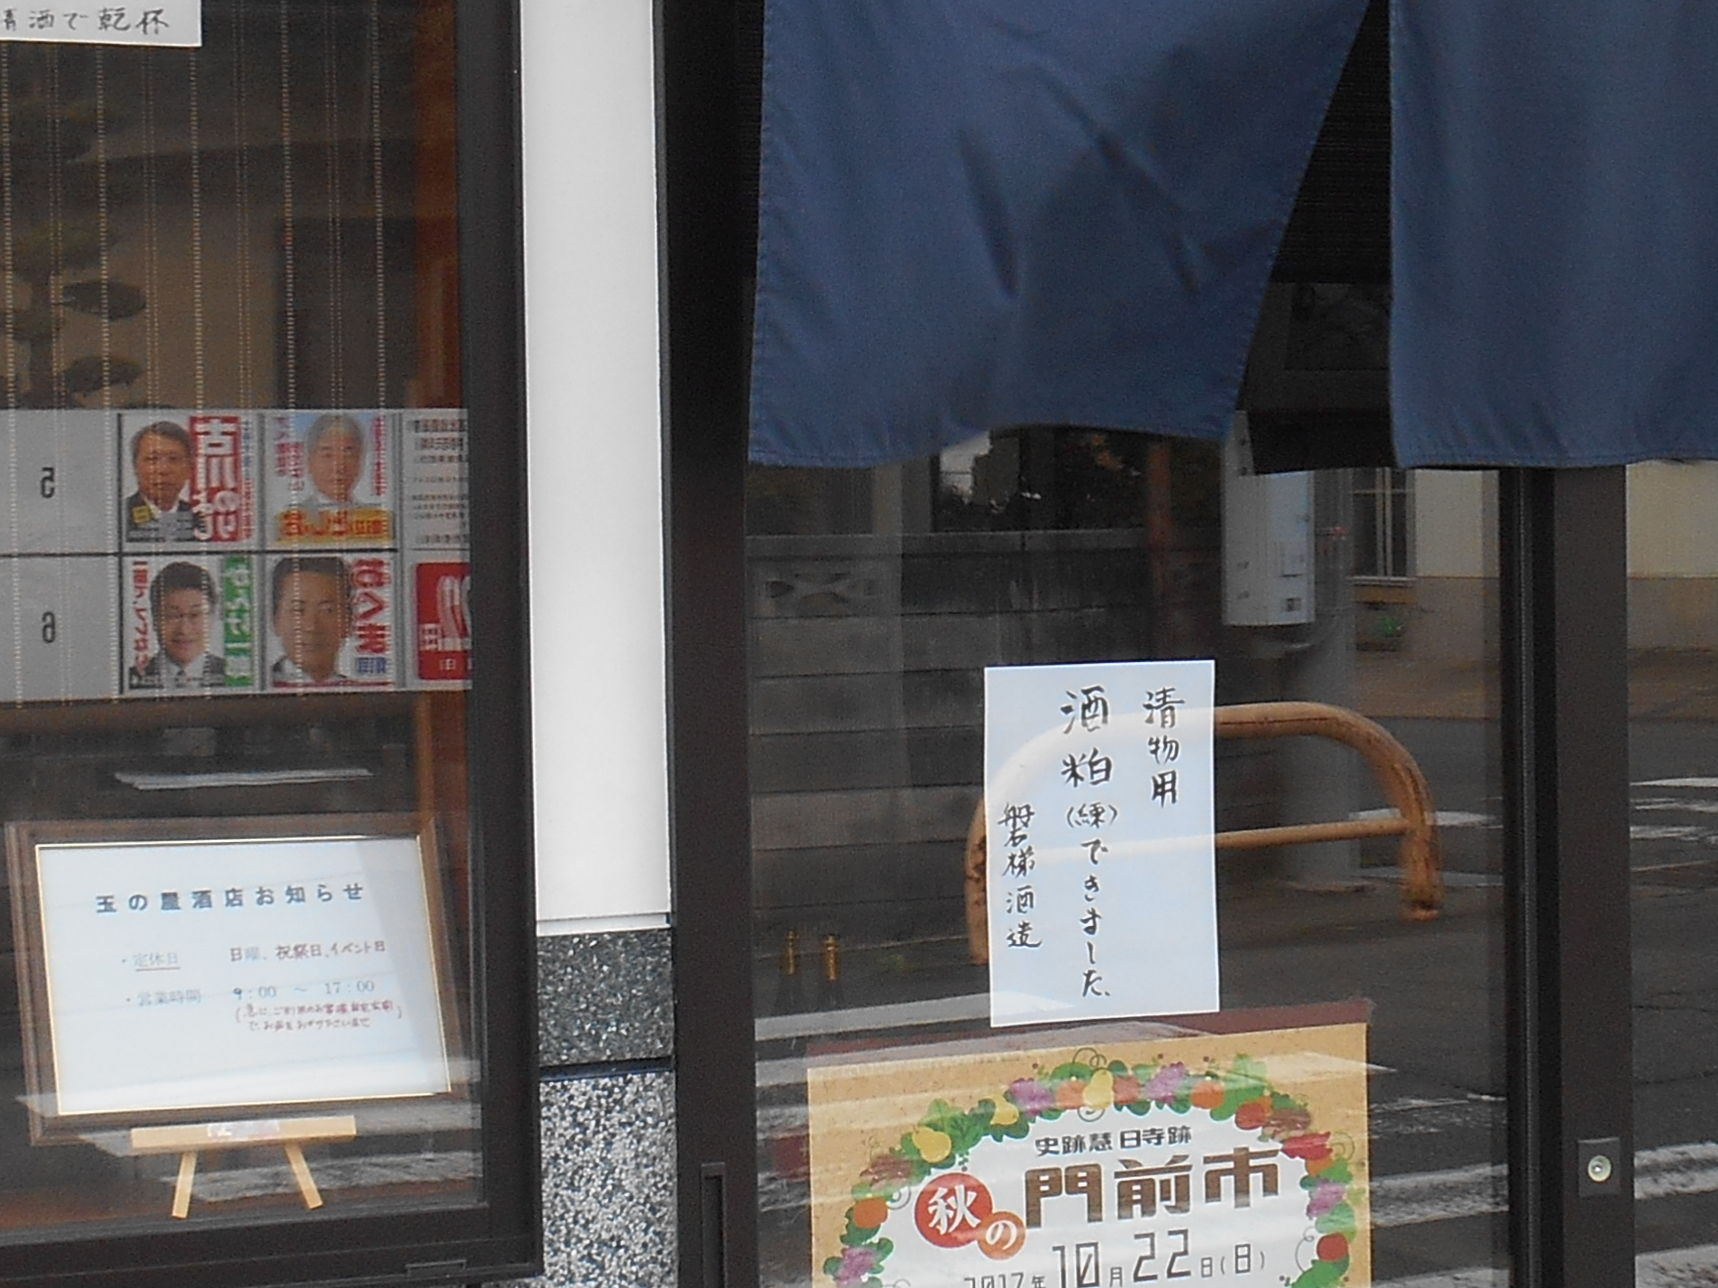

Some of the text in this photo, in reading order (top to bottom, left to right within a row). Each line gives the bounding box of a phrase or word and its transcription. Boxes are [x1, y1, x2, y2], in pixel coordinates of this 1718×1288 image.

[928, 1147, 1281, 1251] 秋の 門前市
